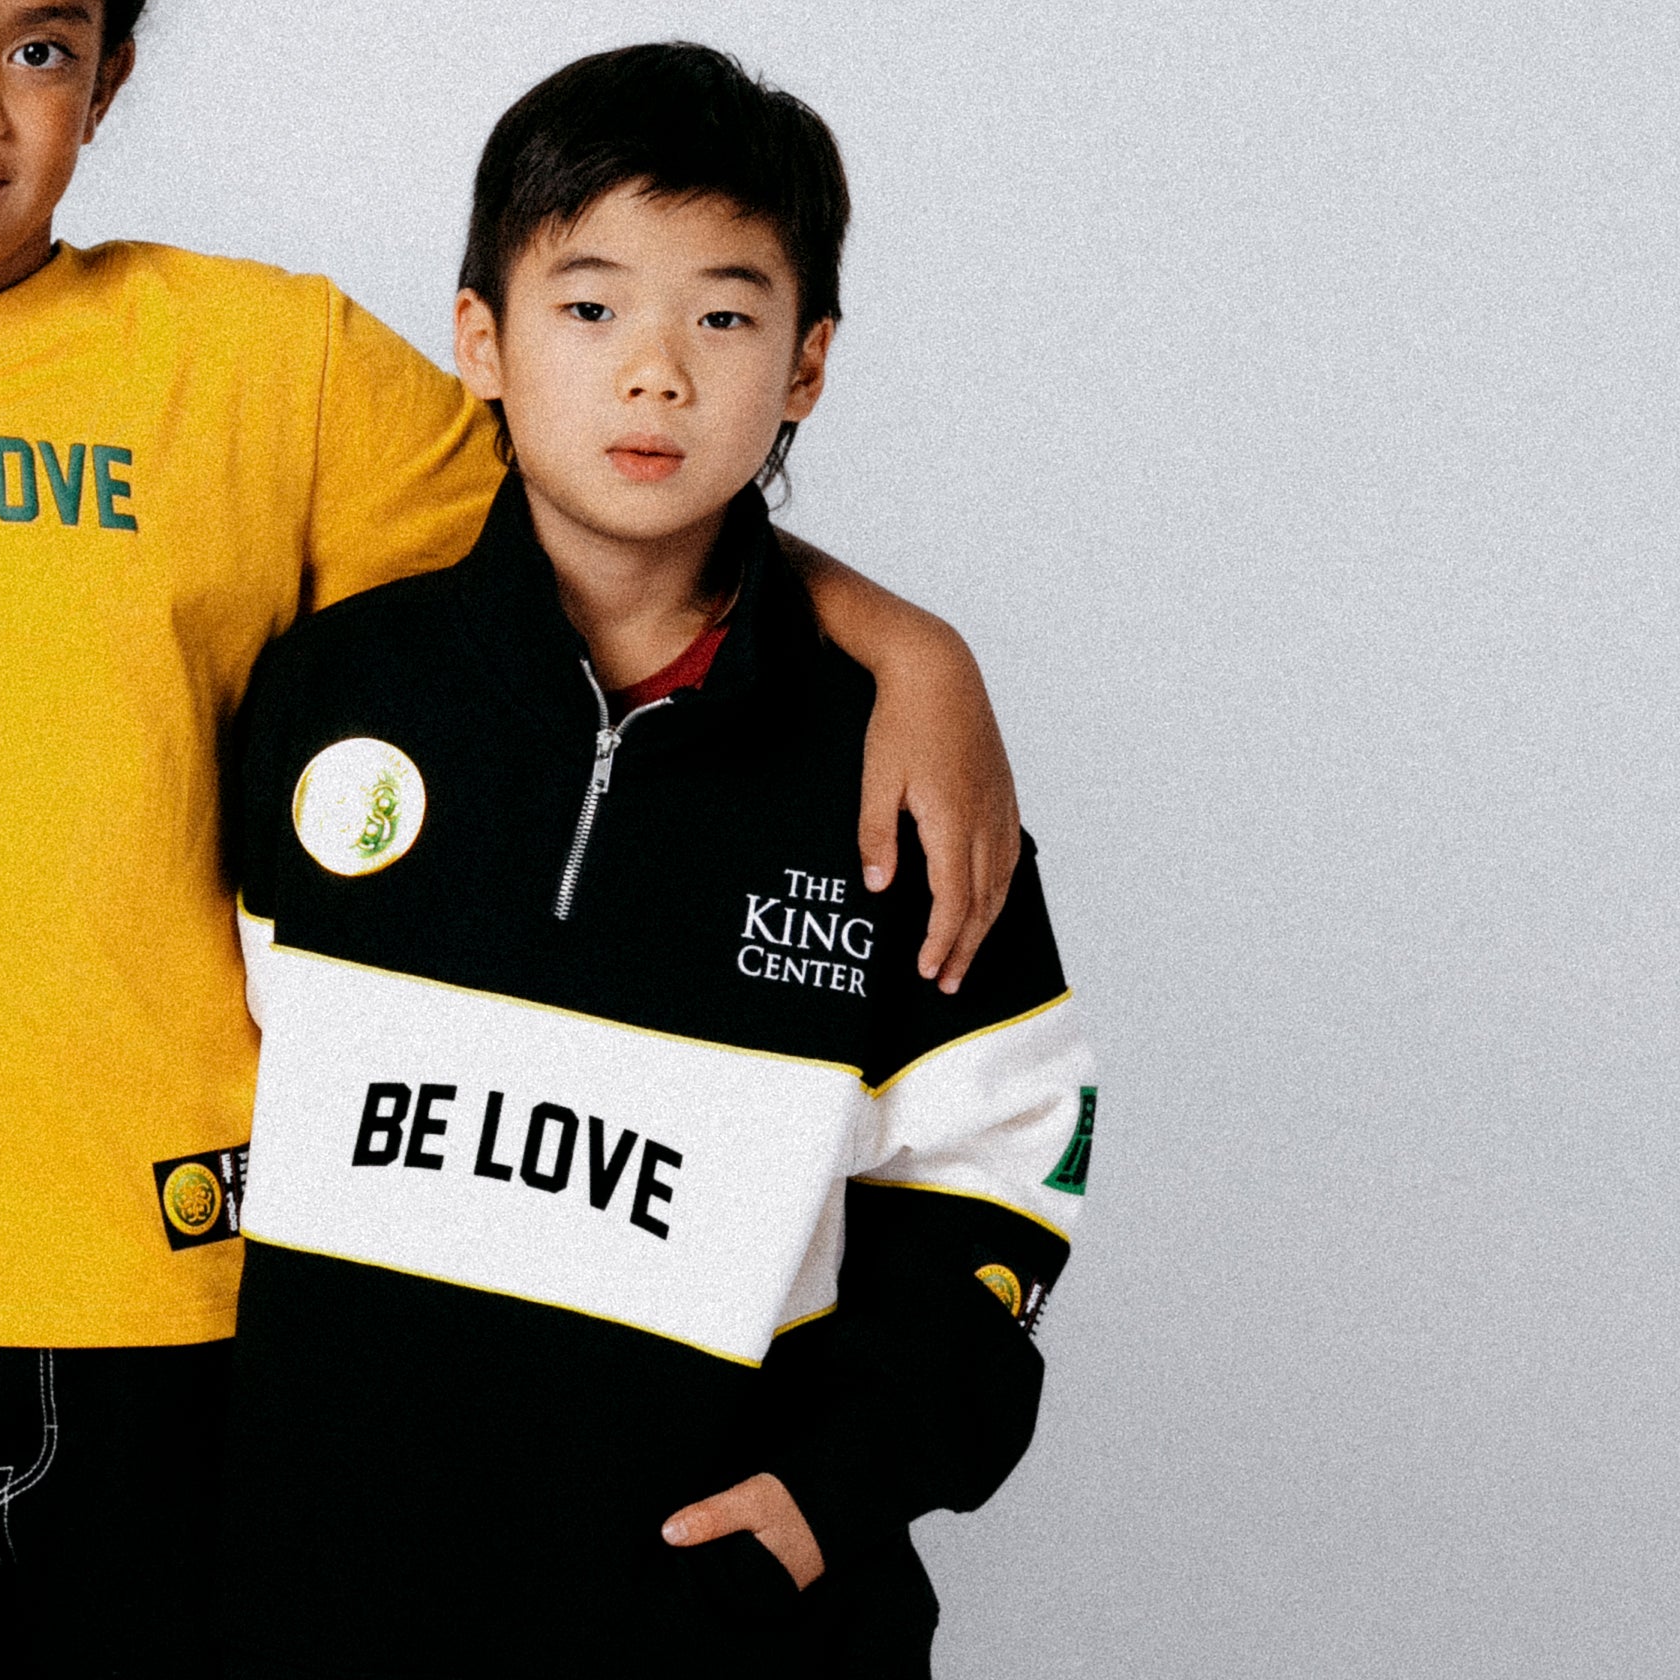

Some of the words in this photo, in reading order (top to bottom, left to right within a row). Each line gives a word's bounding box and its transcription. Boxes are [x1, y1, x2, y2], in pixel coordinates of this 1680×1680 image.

[783, 868, 847, 904] THE
[740, 893, 874, 960] KING
[737, 944, 867, 998] CENTER
[351, 1081, 458, 1170] BE
[473, 1089, 683, 1241] LOVE
